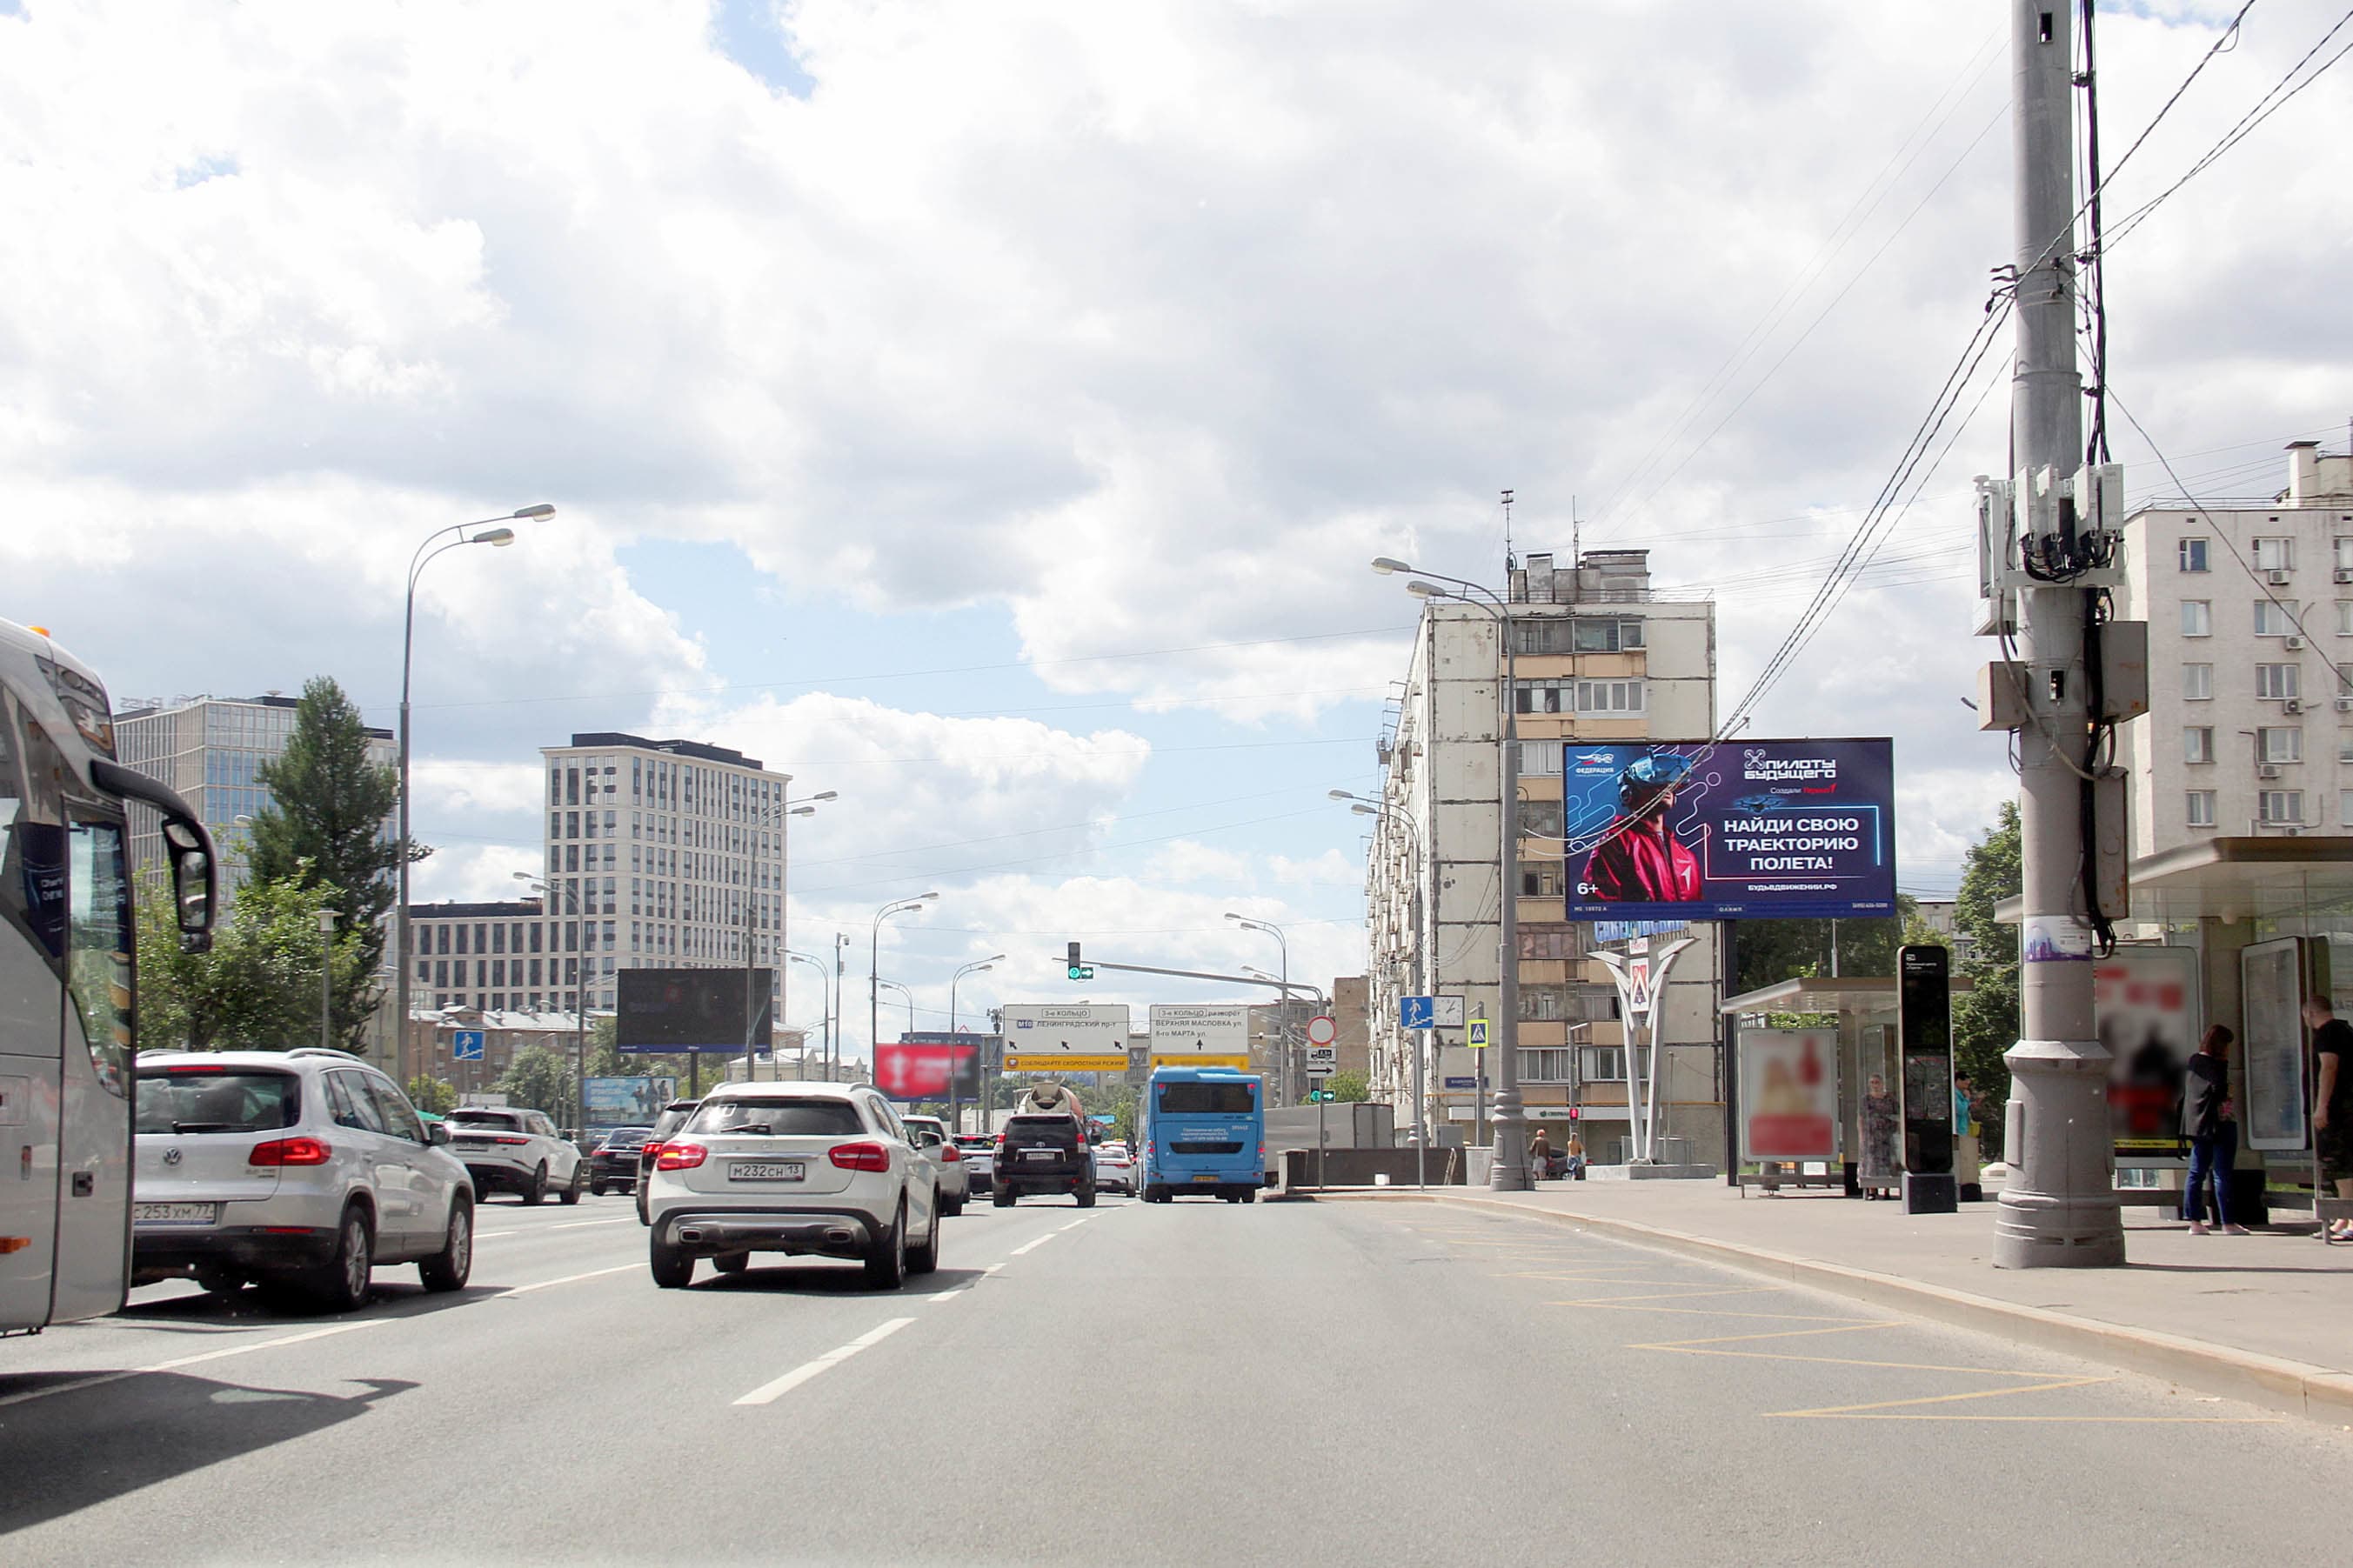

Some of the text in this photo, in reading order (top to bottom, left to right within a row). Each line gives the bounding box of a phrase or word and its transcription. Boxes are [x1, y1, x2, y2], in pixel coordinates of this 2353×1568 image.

[1765, 758, 1836, 770] ПИЛОТЫ
[1723, 816, 1860, 834] НАЙДИ СВОЮ
[1723, 837, 1860, 852] ТРАЕКТОРИЮ
[1750, 856, 1834, 871] ПОЛЕТА!
[1576, 882, 1600, 895] 6+
[786, 1165, 799, 1174] 13
[194, 1204, 211, 1215] 77
